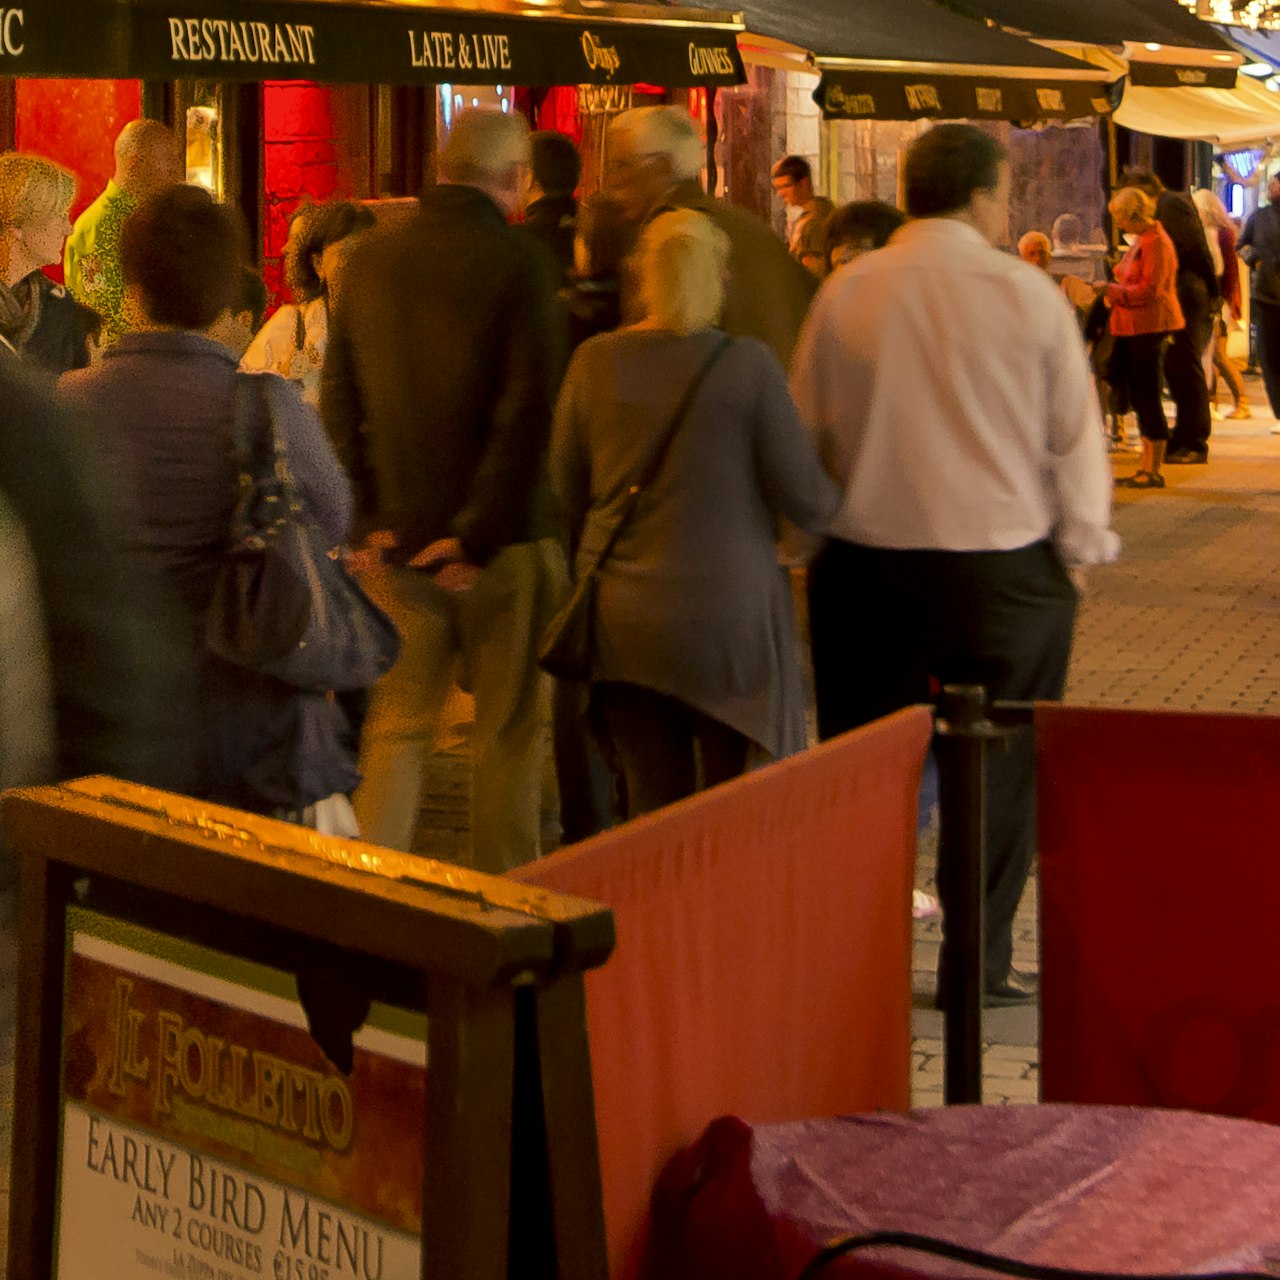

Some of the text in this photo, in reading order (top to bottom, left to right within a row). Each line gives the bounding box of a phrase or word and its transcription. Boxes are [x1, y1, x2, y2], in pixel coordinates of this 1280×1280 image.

[168, 16, 316, 65] RESTAURANT
[408, 30, 512, 71] LATE & LIVE
[155, 1010, 355, 1151] FOLLETTO
[86, 1114, 176, 1199] EARLY
[188, 1152, 267, 1236] BIRD
[279, 1186, 386, 1280] MENU
[131, 1193, 170, 1235] ANY
[172, 1213, 184, 1240] 2
[187, 1220, 262, 1275] COURSES
